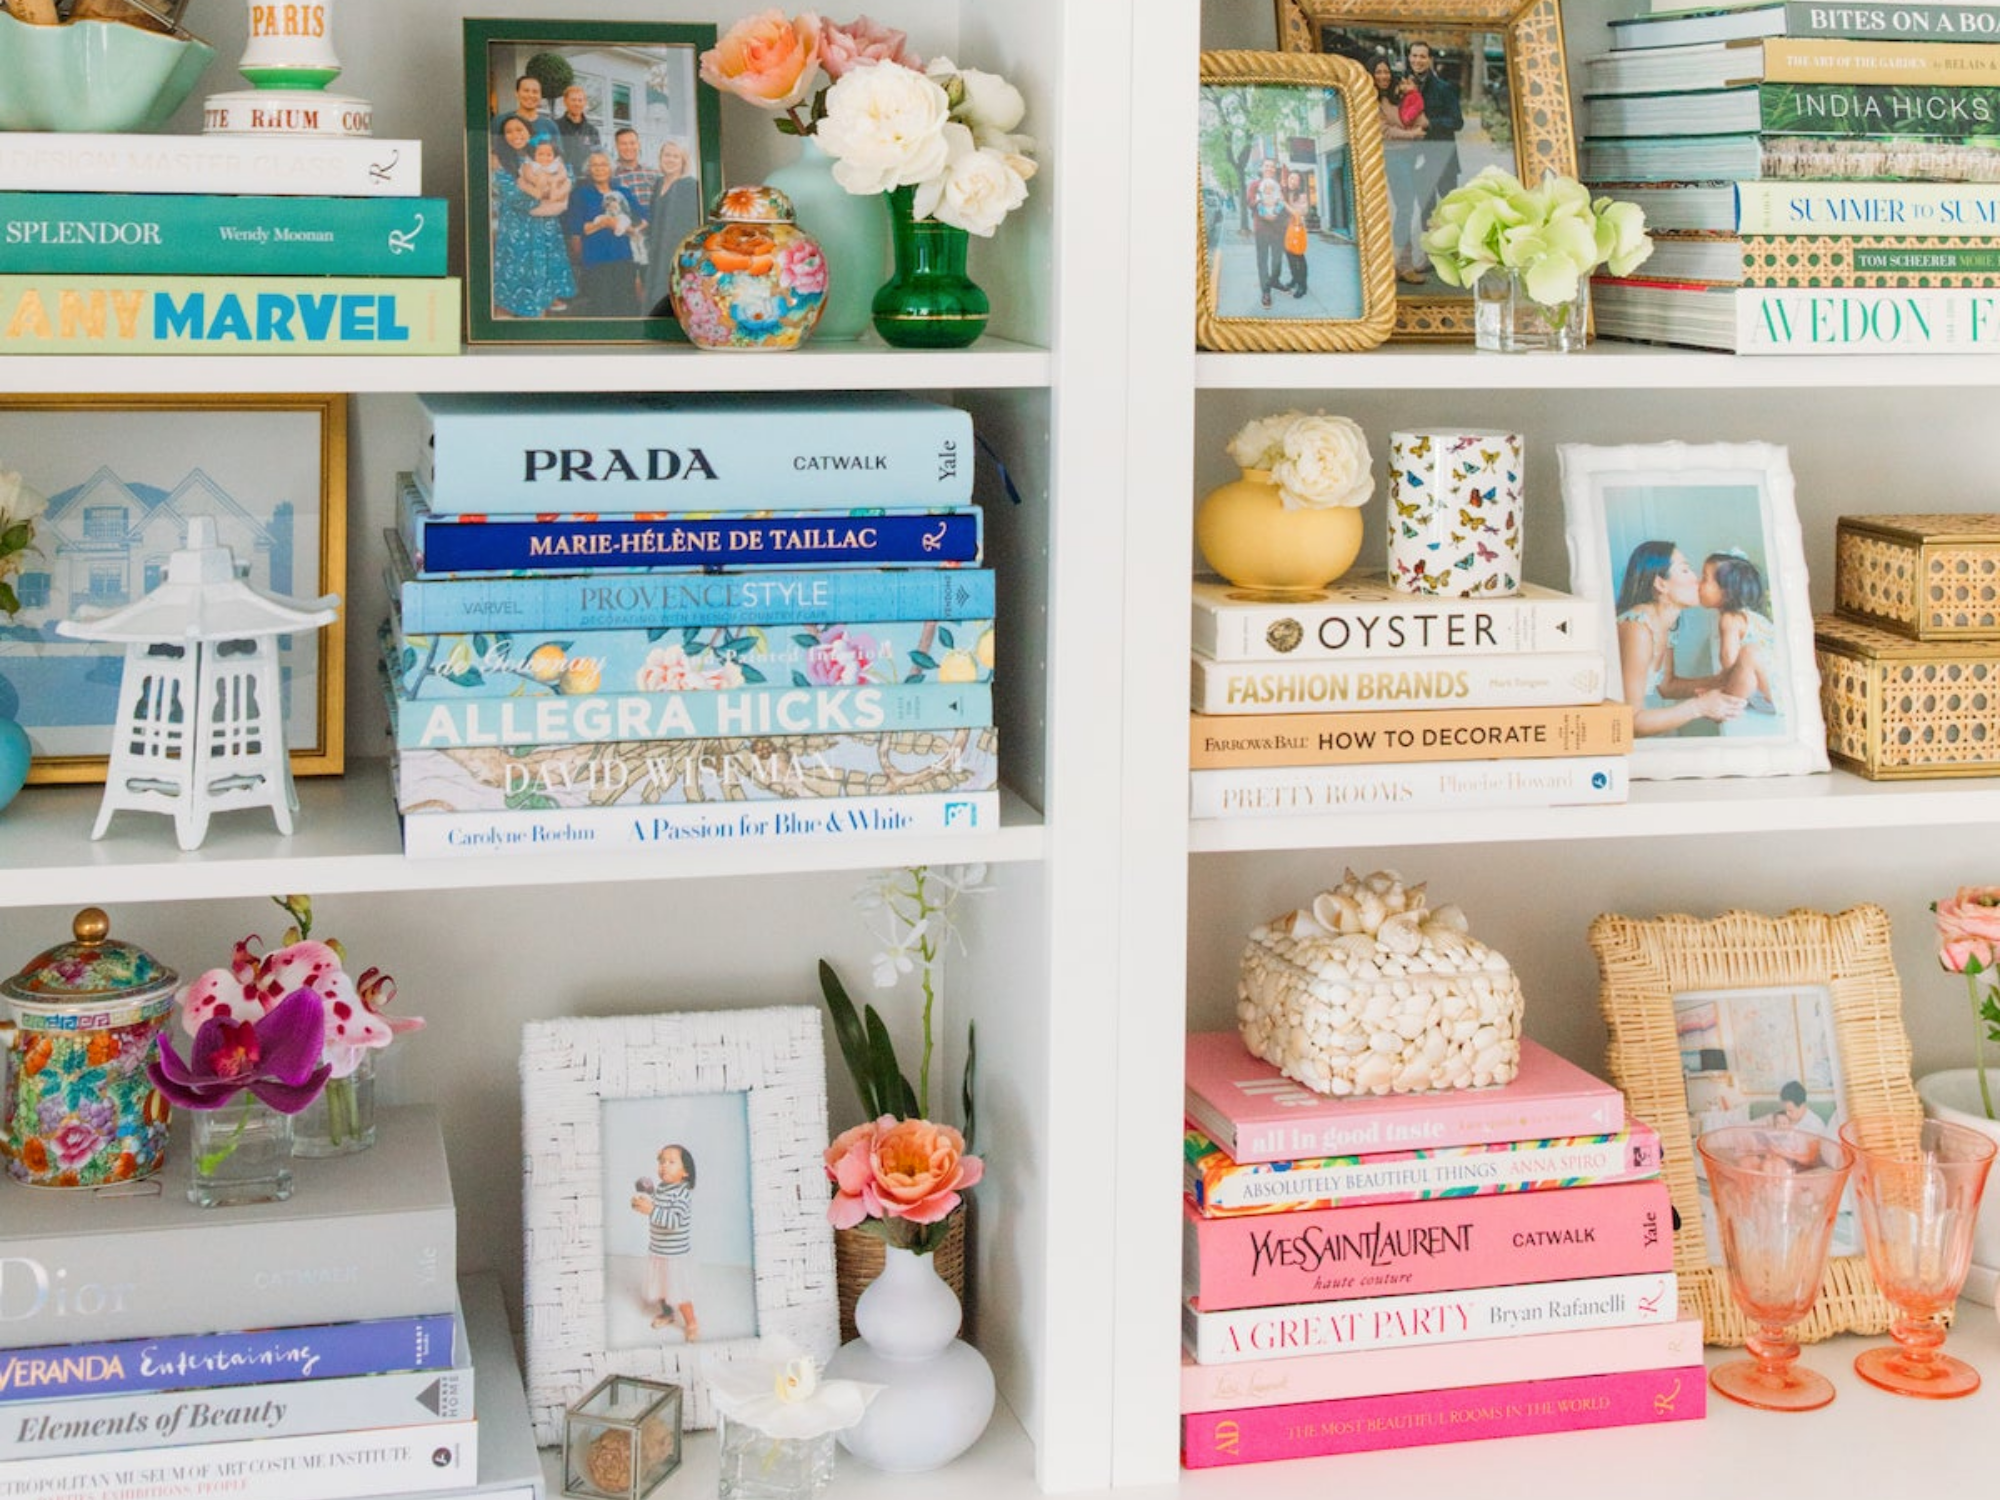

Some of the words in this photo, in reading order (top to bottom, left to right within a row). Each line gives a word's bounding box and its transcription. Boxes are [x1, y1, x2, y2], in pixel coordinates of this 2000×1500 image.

[252, 4, 325, 37] PARIS
[1811, 8, 1886, 30] BITES
[1893, 11, 1929, 31] ON
[1936, 13, 1956, 33] A
[1960, 13, 2000, 33] BO
[1787, 55, 1809, 67] THE
[1814, 56, 1835, 67] ART
[1836, 56, 1851, 67] OF
[1854, 56, 1877, 68] THE
[1879, 57, 1926, 68] GARDEN
[1945, 59, 1986, 70] RELAIS
[251, 110, 319, 129] RHUM
[1796, 93, 1883, 118] INDIA
[1894, 96, 1990, 121] HICKS
[12, 149, 118, 171] DESIGN
[129, 151, 241, 175] MASTER
[254, 154, 344, 178] CLASS
[1789, 198, 1905, 222] SUMMER
[1911, 202, 1933, 219] TO
[1940, 198, 2000, 224] SUM
[6, 220, 162, 244] SPLENDOR
[219, 226, 270, 244] Wendy
[274, 227, 334, 242] Moonan
[1859, 255, 1887, 267] TOM
[1889, 255, 1956, 267] SCHEERER
[1959, 256, 1995, 268] MORE
[154, 292, 409, 341] MARVEL
[1752, 296, 1932, 343] AVEDON
[1967, 298, 2000, 342] F
[524, 448, 720, 481] PRADA
[793, 456, 887, 470] CATWALK
[938, 440, 956, 482] Yale
[529, 528, 721, 556] MARIE-HÉLÈNE
[729, 530, 763, 550] DE
[770, 528, 877, 550] TAILLAC
[463, 601, 523, 615] VARVEL
[1318, 614, 1497, 649] OYSTER
[1227, 672, 1349, 705] FASHION
[1357, 670, 1469, 701] BRANDS
[419, 694, 697, 747] ALLEGRA
[717, 688, 885, 734] HICKS
[1319, 731, 1376, 750] HOW
[1384, 730, 1415, 748] TO
[1422, 725, 1547, 747] DECORATE
[505, 757, 629, 796] DAVID
[645, 751, 836, 788] WISEMAN
[1222, 785, 1314, 809] PRETTY
[1326, 781, 1413, 805] ROOMS
[1439, 772, 1502, 793] Phoebe
[1507, 770, 1573, 790] Howard
[448, 826, 527, 850] Carolyne
[532, 823, 594, 842] Roehm
[630, 820, 645, 841] A
[653, 816, 733, 840] Passion
[739, 813, 769, 837] for
[776, 811, 822, 835] Blue
[826, 811, 843, 832] &
[848, 807, 913, 831] White
[1252, 1129, 1284, 1154] all
[1293, 1127, 1317, 1150] in
[1323, 1121, 1379, 1151] good
[1386, 1119, 1445, 1142] taste
[1243, 1175, 1342, 1199] ABSOLUTELY
[1346, 1168, 1429, 1189] BEAUTIFUL
[1435, 1162, 1498, 1182] THINGS
[1510, 1158, 1556, 1175] ANNA
[1561, 1153, 1607, 1170] SPIRO
[1513, 1228, 1596, 1247] CATWALK
[1643, 1211, 1659, 1248] Yale
[0, 1257, 135, 1321] Dior
[254, 1265, 359, 1289] CATWALK
[1314, 1274, 1355, 1290] haute
[1360, 1272, 1413, 1286] couture
[1221, 1326, 1241, 1352] A
[1250, 1313, 1363, 1349] GREAT
[1374, 1302, 1474, 1339] PARTY
[1490, 1305, 1542, 1328] Bryan
[1549, 1294, 1626, 1318] Rafanelli
[0, 1355, 125, 1391] VERANDA
[140, 1344, 320, 1376] Entertaining
[449, 1375, 458, 1417] HOME
[15, 1411, 149, 1443] Elements
[155, 1403, 188, 1437] of
[189, 1400, 287, 1430] Beauty
[1288, 1425, 1316, 1441] THE
[1321, 1421, 1362, 1437] MOST
[1367, 1411, 1445, 1432] BEAUTIFUL
[1450, 1405, 1502, 1424] ROOMS
[1506, 1404, 1522, 1418] IN
[1527, 1401, 1554, 1416] THE
[1558, 1396, 1611, 1414] WORLD
[1214, 1419, 1240, 1456] AD
[115, 1467, 185, 1487] MUSEUM
[188, 1463, 210, 1479] OF
[216, 1460, 246, 1477] ART
[249, 1451, 327, 1474] COSTUME
[330, 1446, 412, 1468] INSTITUTE
